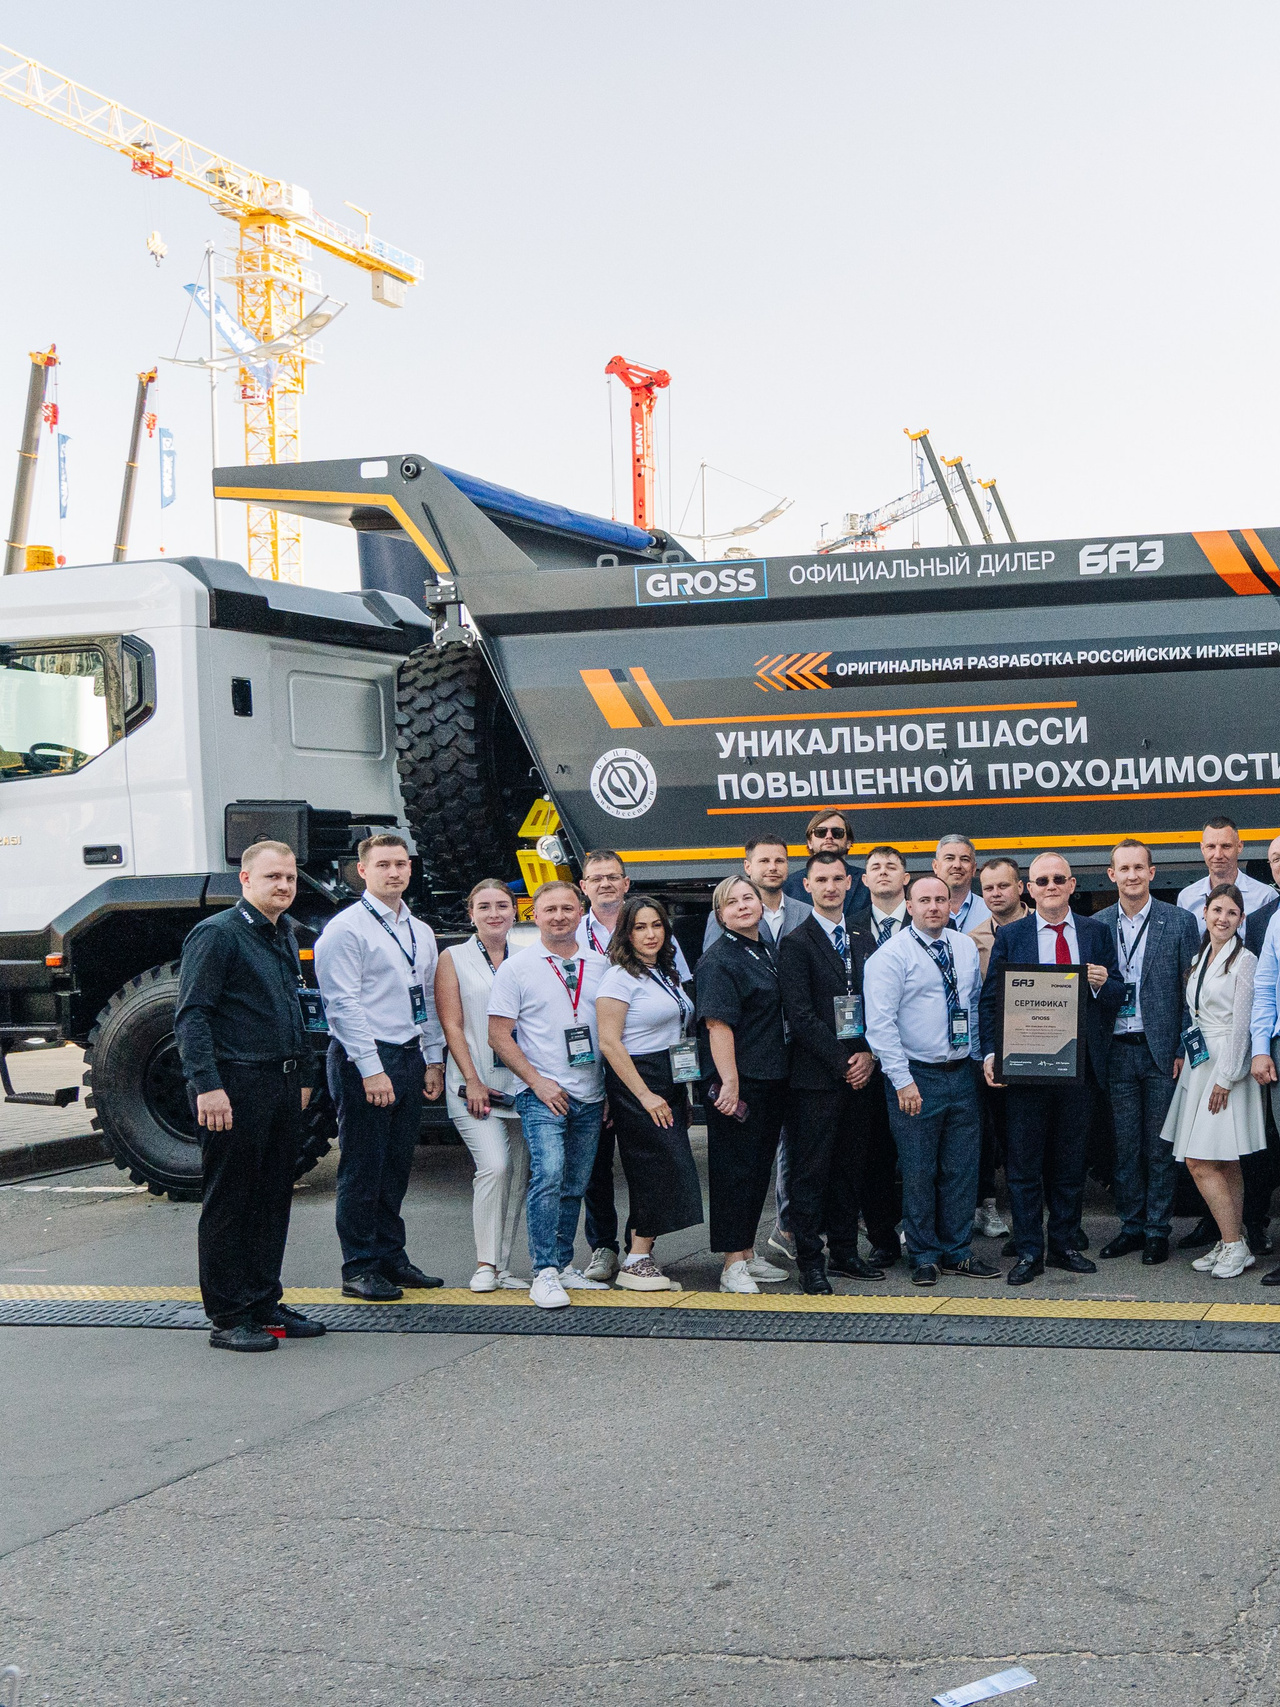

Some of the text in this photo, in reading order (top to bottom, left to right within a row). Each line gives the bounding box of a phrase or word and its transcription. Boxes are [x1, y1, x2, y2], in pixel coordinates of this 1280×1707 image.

[634, 421, 644, 456] SANY
[788, 550, 1056, 585] ОФИЦИАЛЬНЫЙ ДИЛЕР
[1079, 540, 1164, 575] БАЗ
[645, 567, 758, 599] GROSS
[835, 656, 965, 678] ОРИГИНАЛЬНАЯ
[967, 651, 1074, 671] РАЗРАБОТКА
[1076, 645, 1192, 664] РОССИЙСКИХ
[715, 716, 1089, 759] УНИКАЛЬНОЕ ШАССИ
[717, 758, 974, 801] ПОВЫШЕННОЙ
[1011, 978, 1035, 988] БАЗ
[1014, 999, 1069, 1008] СЕРТИФИКАТ
